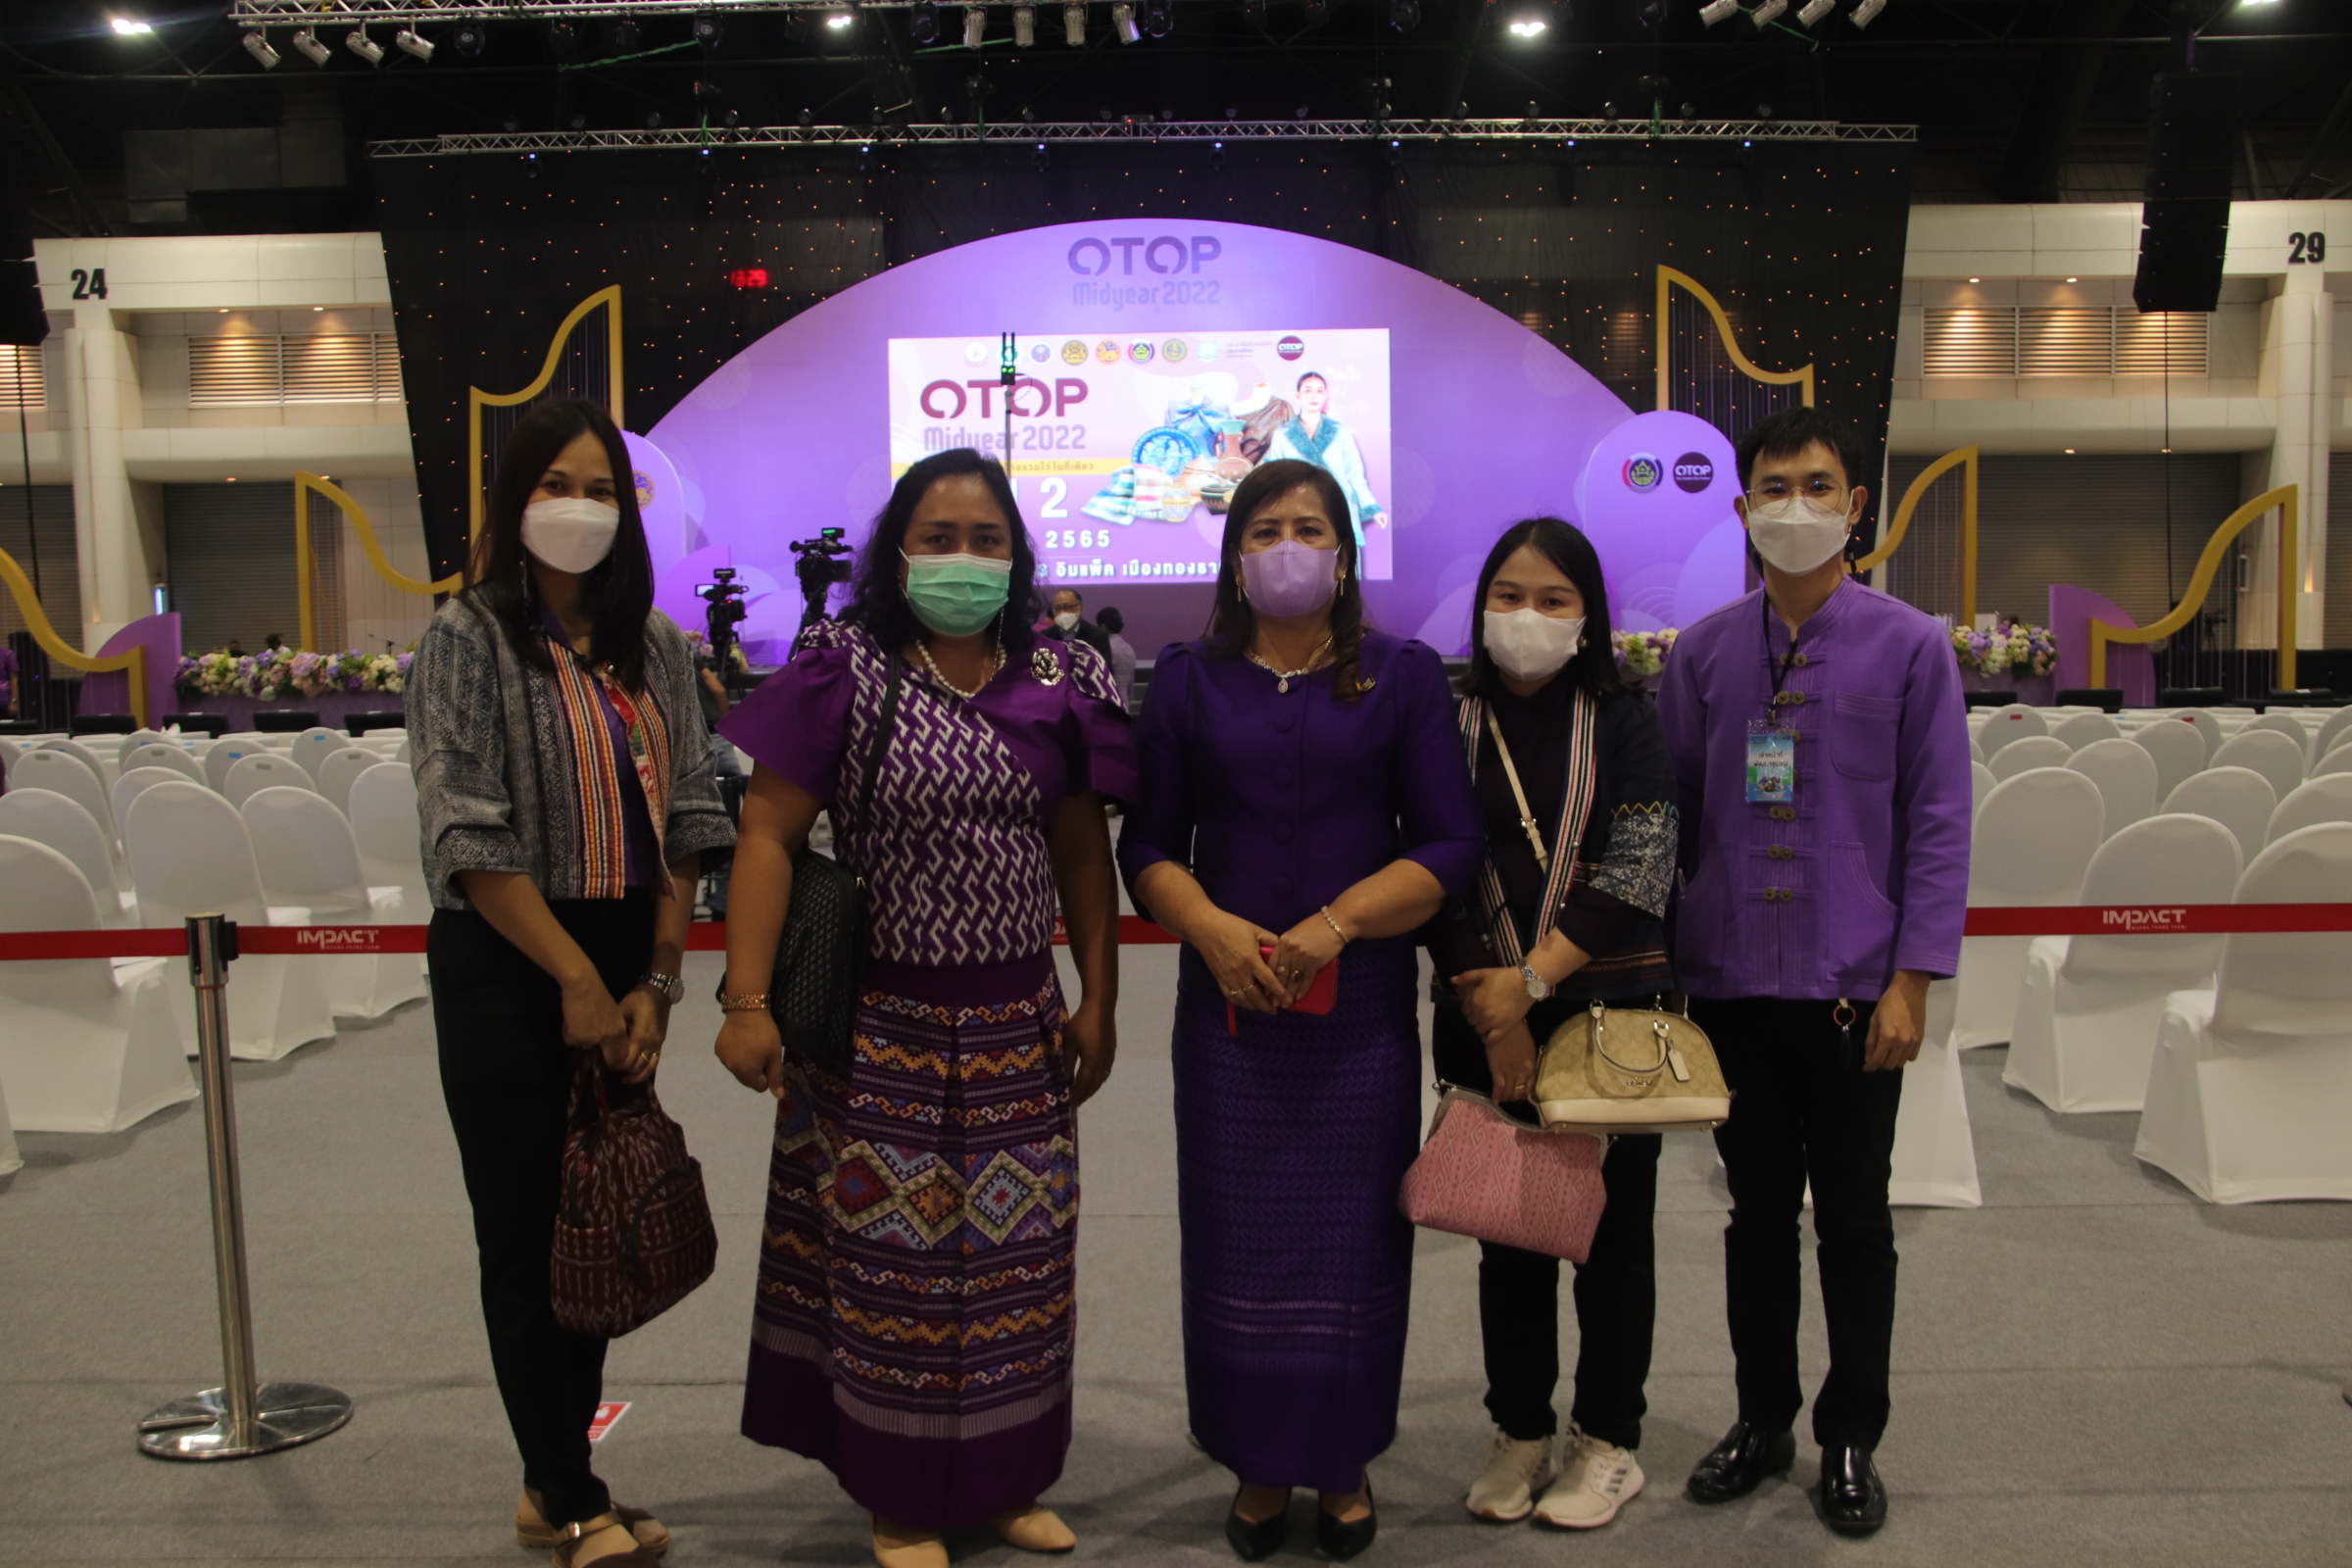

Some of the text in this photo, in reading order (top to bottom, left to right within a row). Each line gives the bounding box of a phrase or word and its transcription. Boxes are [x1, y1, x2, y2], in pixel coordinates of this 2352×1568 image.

[1068, 235, 1221, 275] OTOP
[2288, 231, 2326, 265] 29
[71, 269, 108, 300] 24
[1073, 280, 1220, 312] Midyear 2022
[920, 377, 1089, 419] OTOP
[1022, 424, 1086, 451] 2022
[1675, 465, 1711, 476] OTOP
[1040, 476, 1068, 517] 2
[1046, 530, 1110, 549] 2565
[1122, 559, 1221, 576] เมืองทองธา
[2102, 908, 2186, 931] IMPACT
[297, 929, 379, 950] IMPACT
